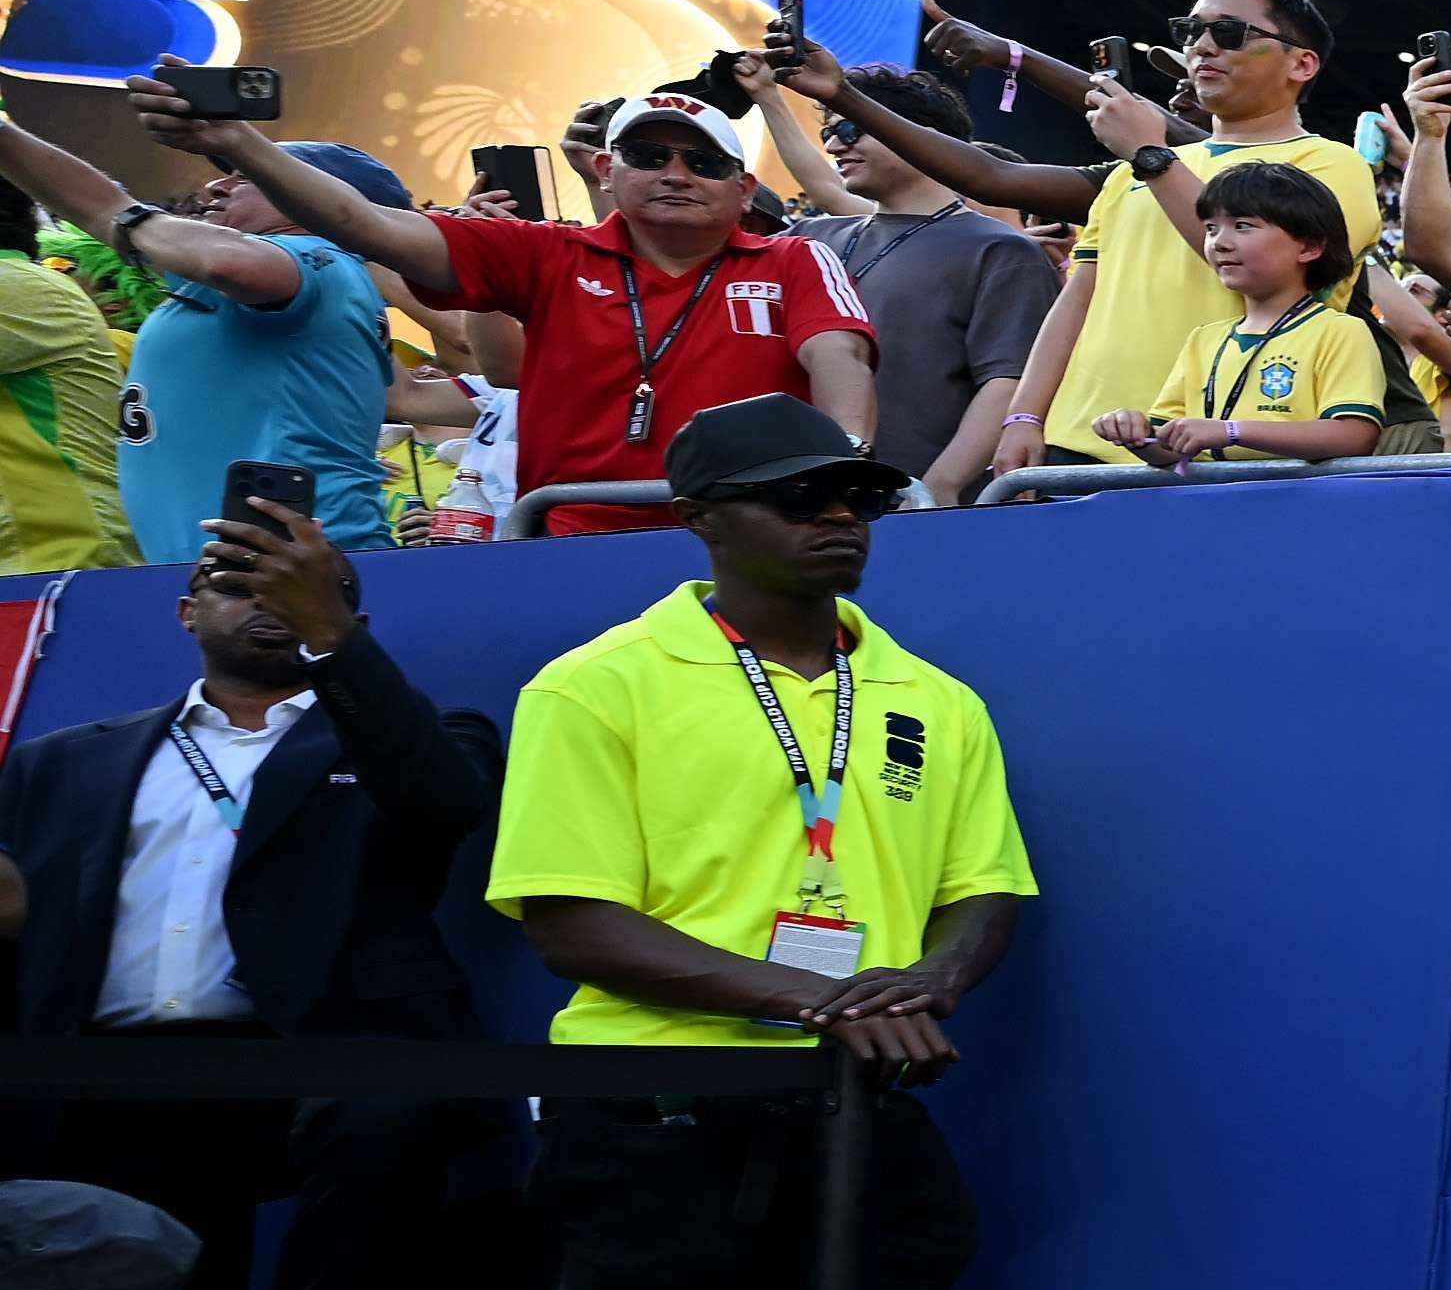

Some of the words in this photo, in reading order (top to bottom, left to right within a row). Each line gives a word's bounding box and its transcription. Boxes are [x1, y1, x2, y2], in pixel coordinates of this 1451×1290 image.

[732, 284, 778, 297] FPF
[1257, 404, 1293, 413] BRASIL
[836, 653, 849, 672] FIFA
[754, 684, 777, 708] CUP
[837, 672, 853, 709] WORLD
[766, 706, 797, 748] WORLD
[836, 708, 851, 731] CUP
[786, 747, 807, 773] FIFA
